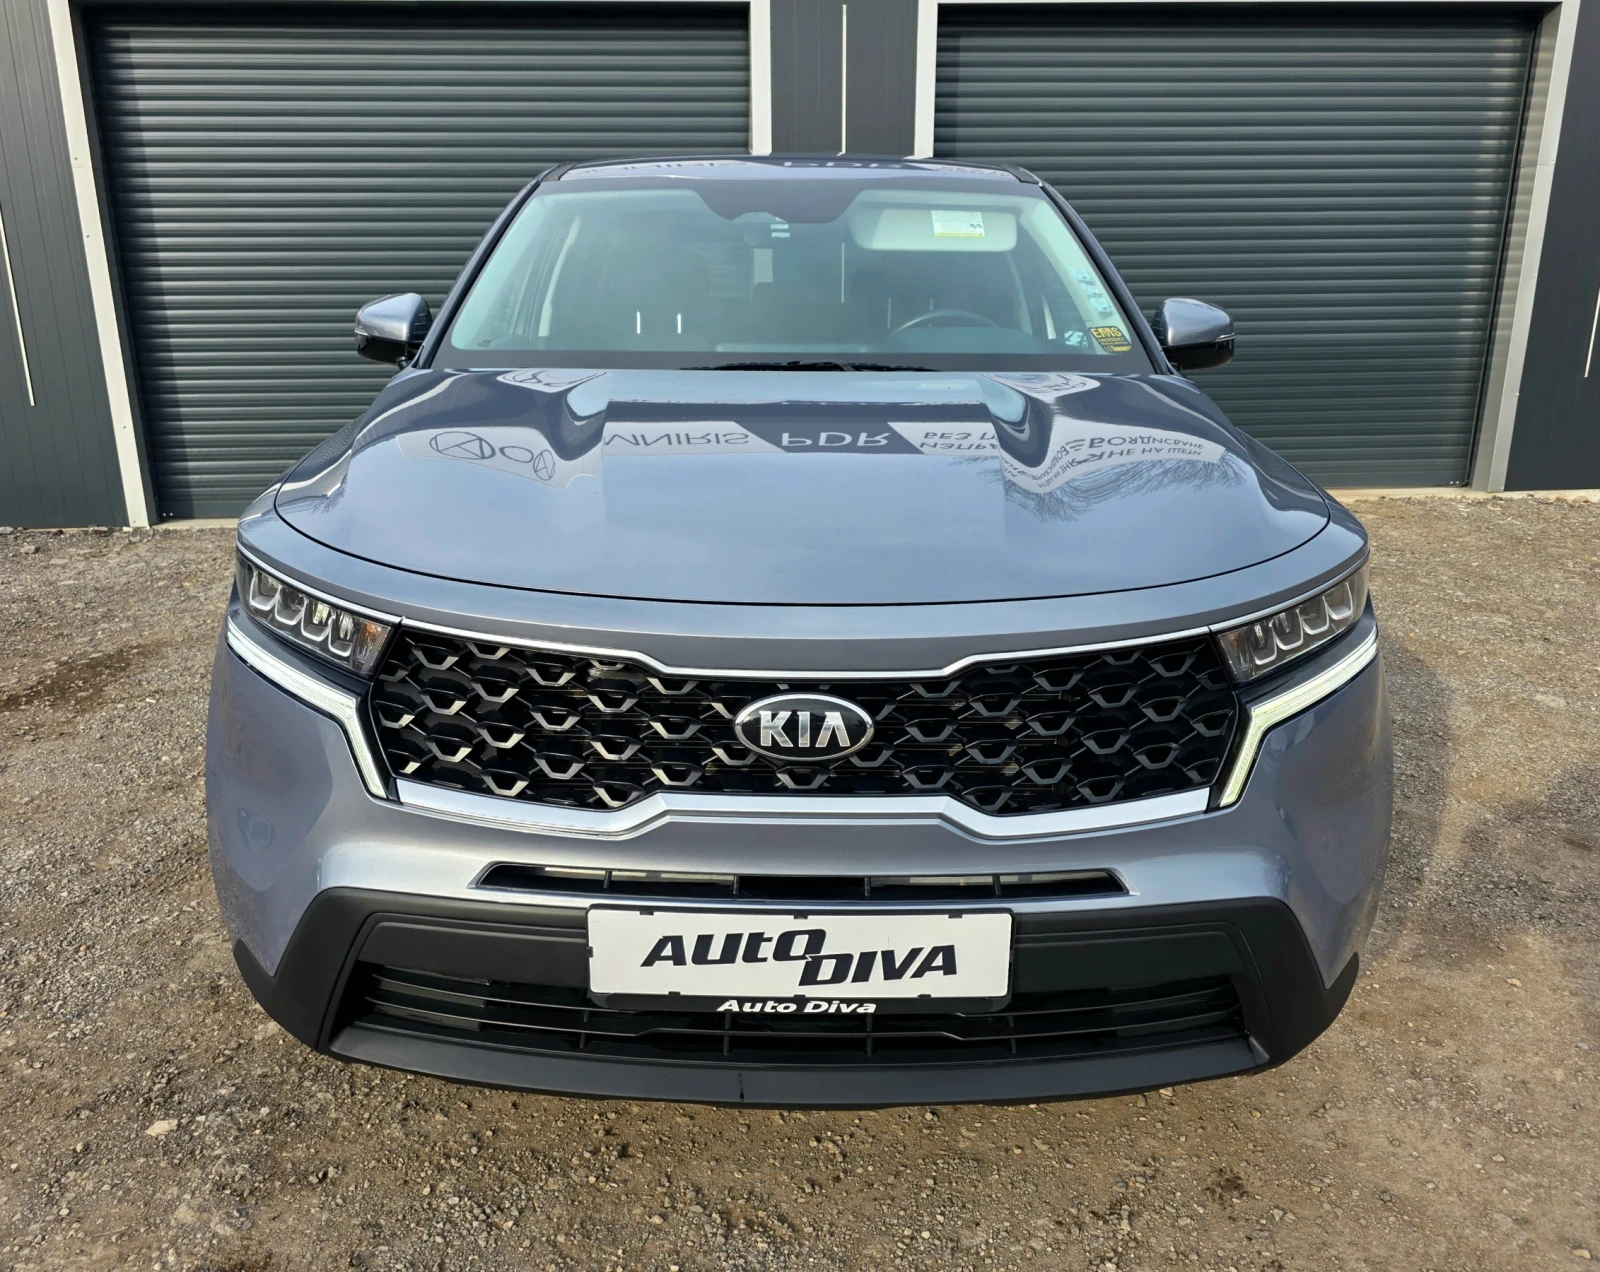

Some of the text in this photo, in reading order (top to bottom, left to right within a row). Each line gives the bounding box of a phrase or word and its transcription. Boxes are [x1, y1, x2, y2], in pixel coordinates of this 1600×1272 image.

[1090, 327, 1122, 337] EMS
[759, 711, 851, 748] KIA
[798, 944, 957, 986] DIVA
[717, 1000, 876, 1014] Auto Diva
